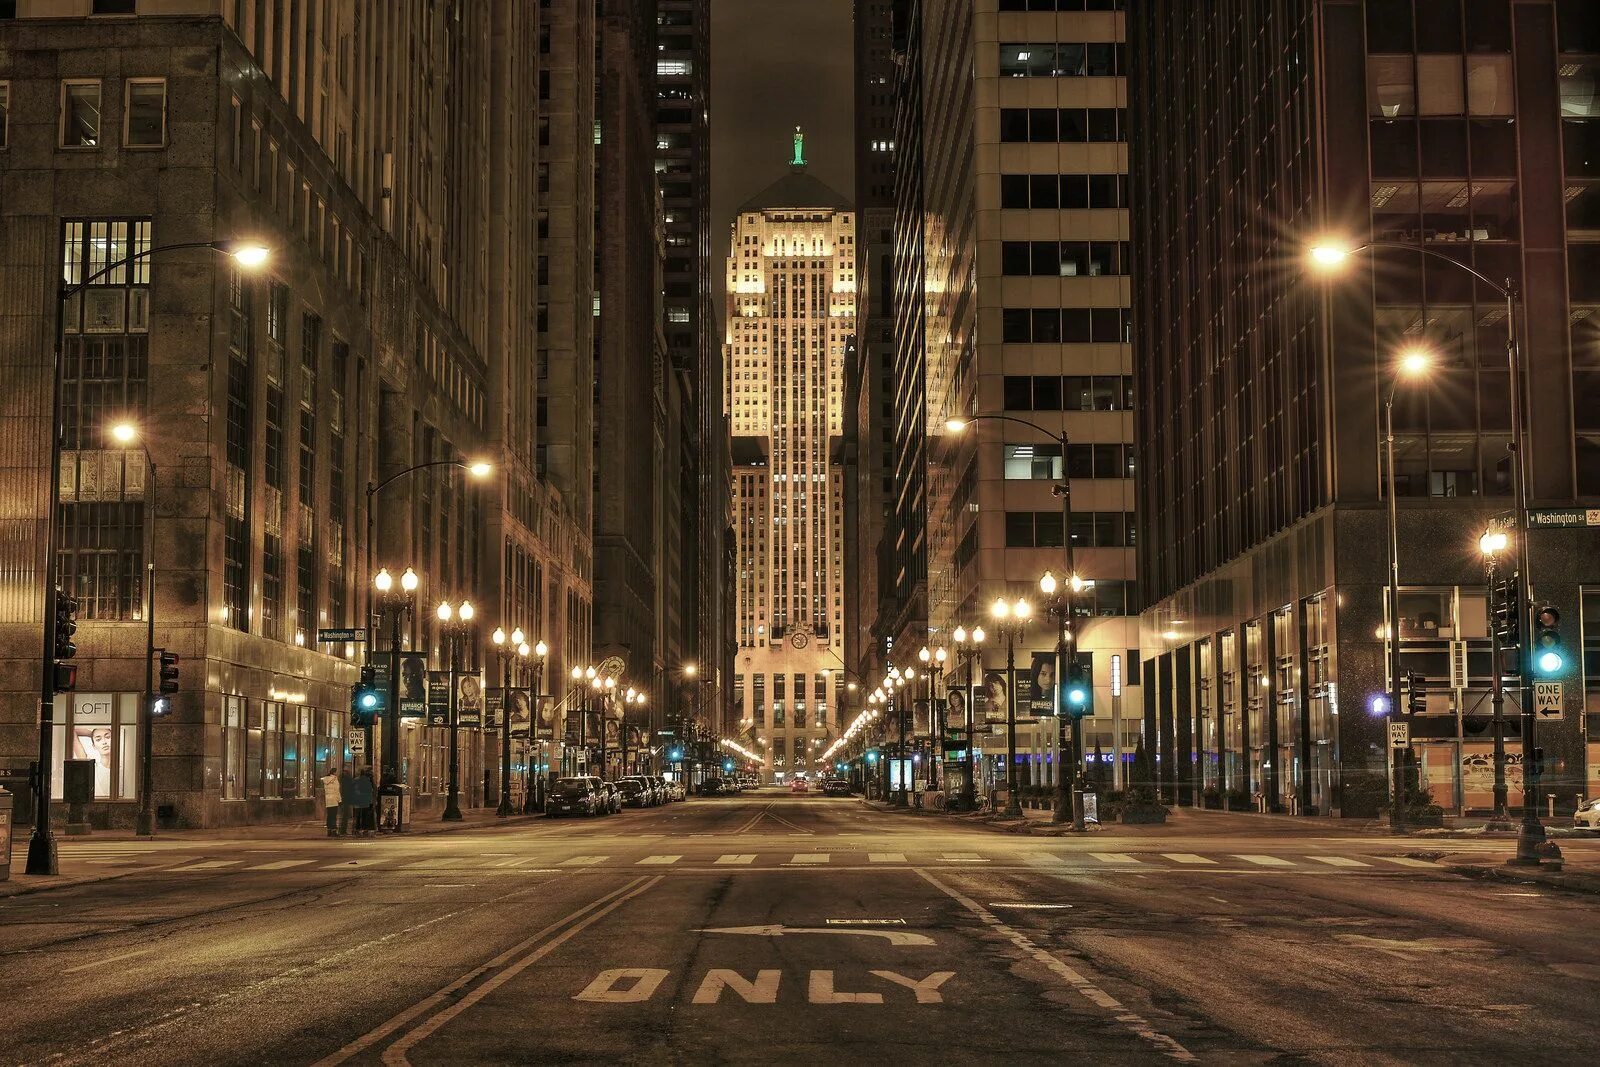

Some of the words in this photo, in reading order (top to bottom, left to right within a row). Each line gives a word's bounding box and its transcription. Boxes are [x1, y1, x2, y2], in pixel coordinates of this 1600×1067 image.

[1536, 512, 1577, 527] Washington
[323, 631, 350, 640] Washington
[1537, 684, 1560, 695] ONE
[1537, 695, 1560, 705] WAY
[75, 702, 110, 715] LOFT
[571, 968, 957, 1004] ONLY
